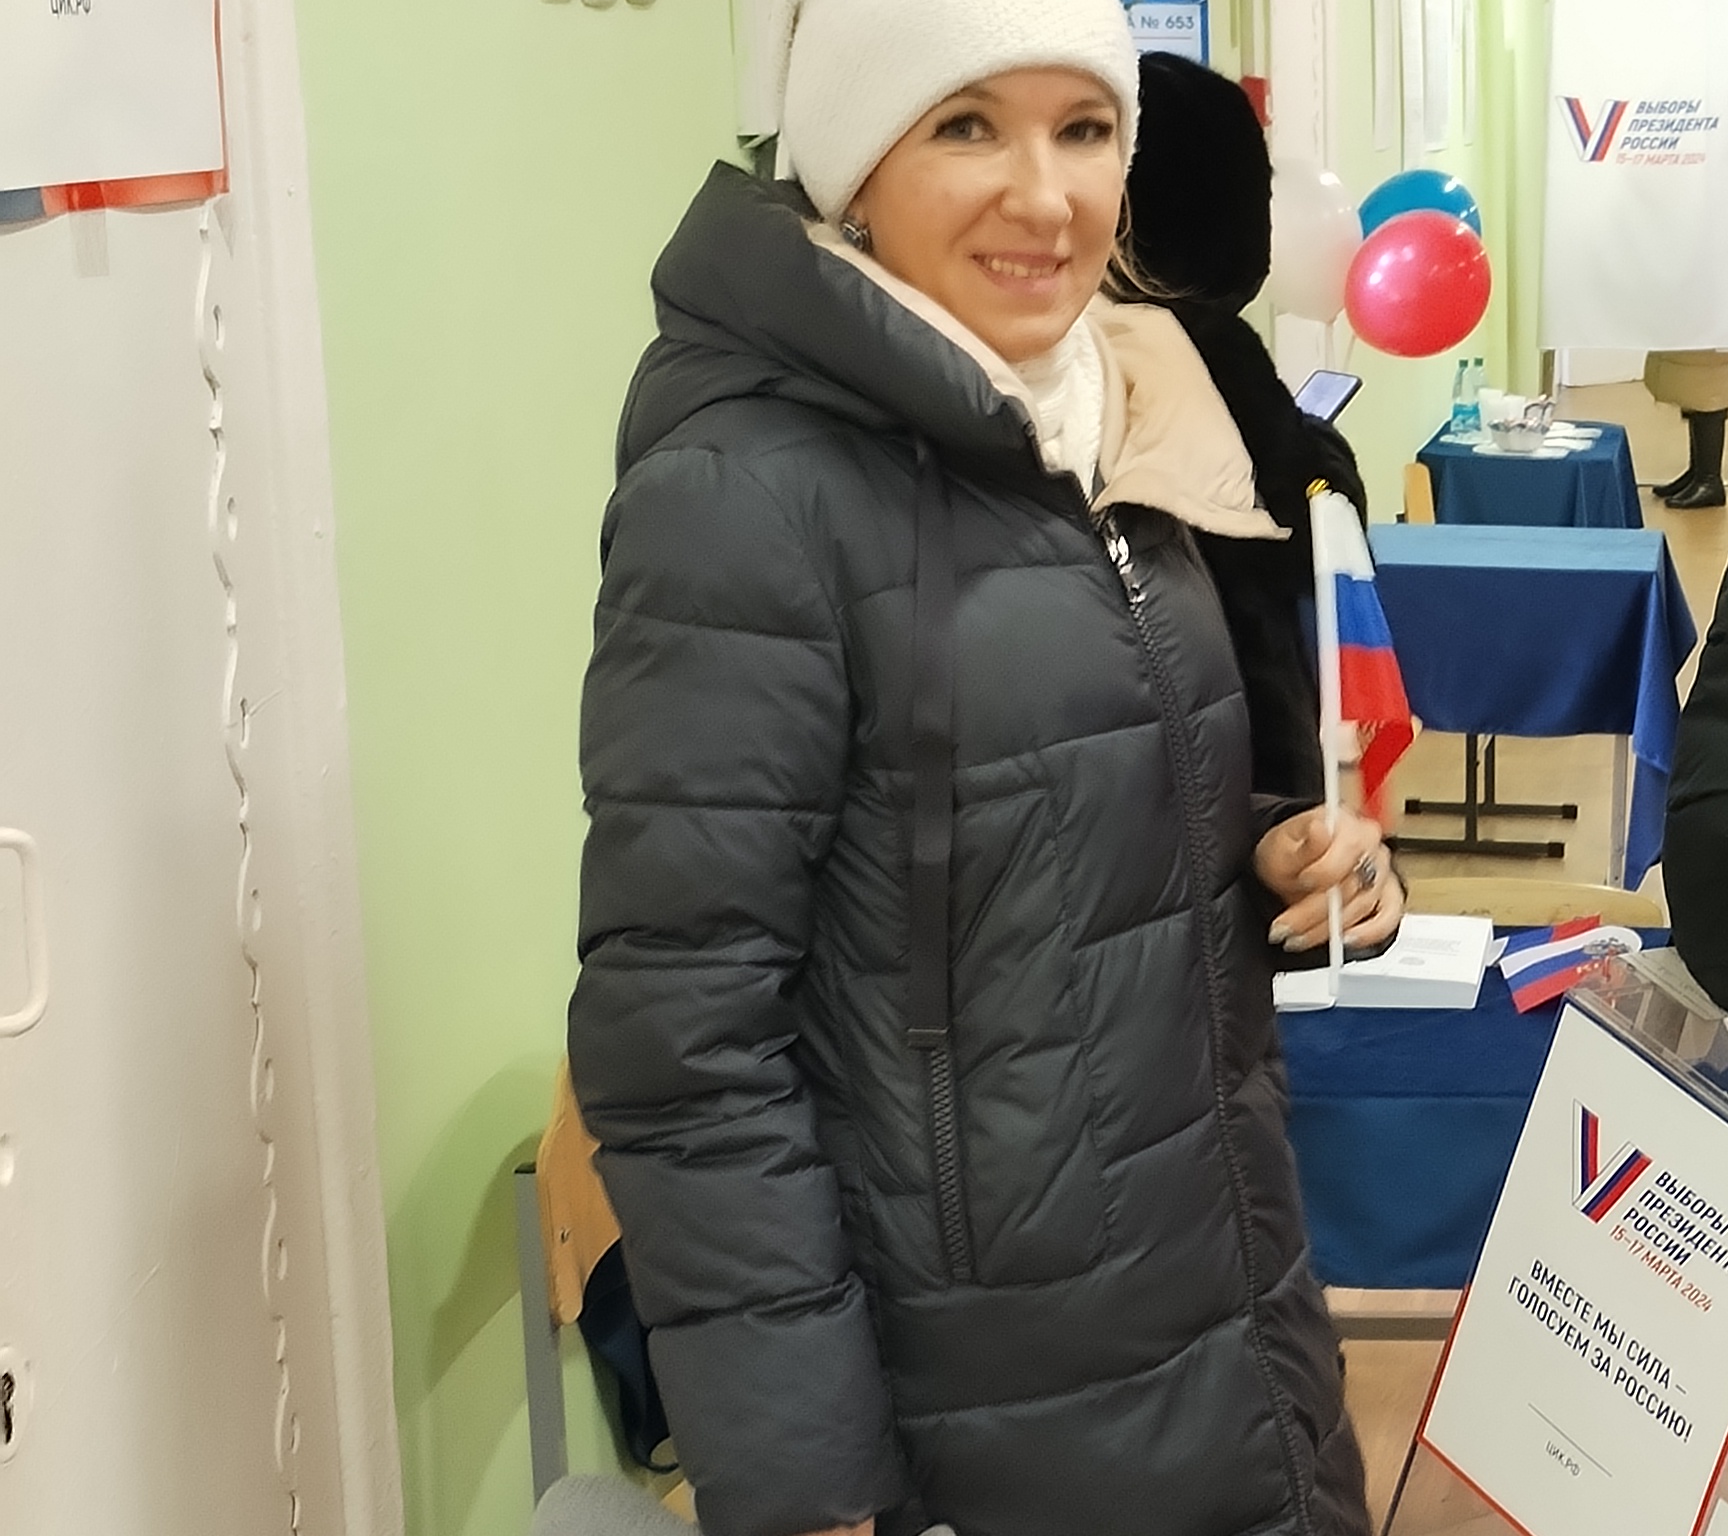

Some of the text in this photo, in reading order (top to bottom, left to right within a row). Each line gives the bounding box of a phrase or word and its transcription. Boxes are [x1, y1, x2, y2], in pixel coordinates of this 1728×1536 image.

[1140, 15, 1160, 30] №
[1165, 16, 1195, 30] 653
[1627, 117, 1720, 134] ПРЕЗИДЕНТА
[1635, 99, 1702, 115] ВЫБОРЫ
[1619, 136, 1681, 150] РОССИИ
[1622, 1206, 1692, 1266] РОССИИ
[1640, 1249, 1684, 1290] МАРТА
[1680, 1282, 1713, 1313] 2024
[1529, 1258, 1593, 1324] ВМЕСТЕ
[1593, 1311, 1626, 1350] МЫ
[1626, 1338, 1671, 1390] СИЛА
[1507, 1275, 1693, 1444] ГОЛОСУЕМ ЗА РОССИЮ!
[1545, 1440, 1582, 1478] ЦИК.РФ
